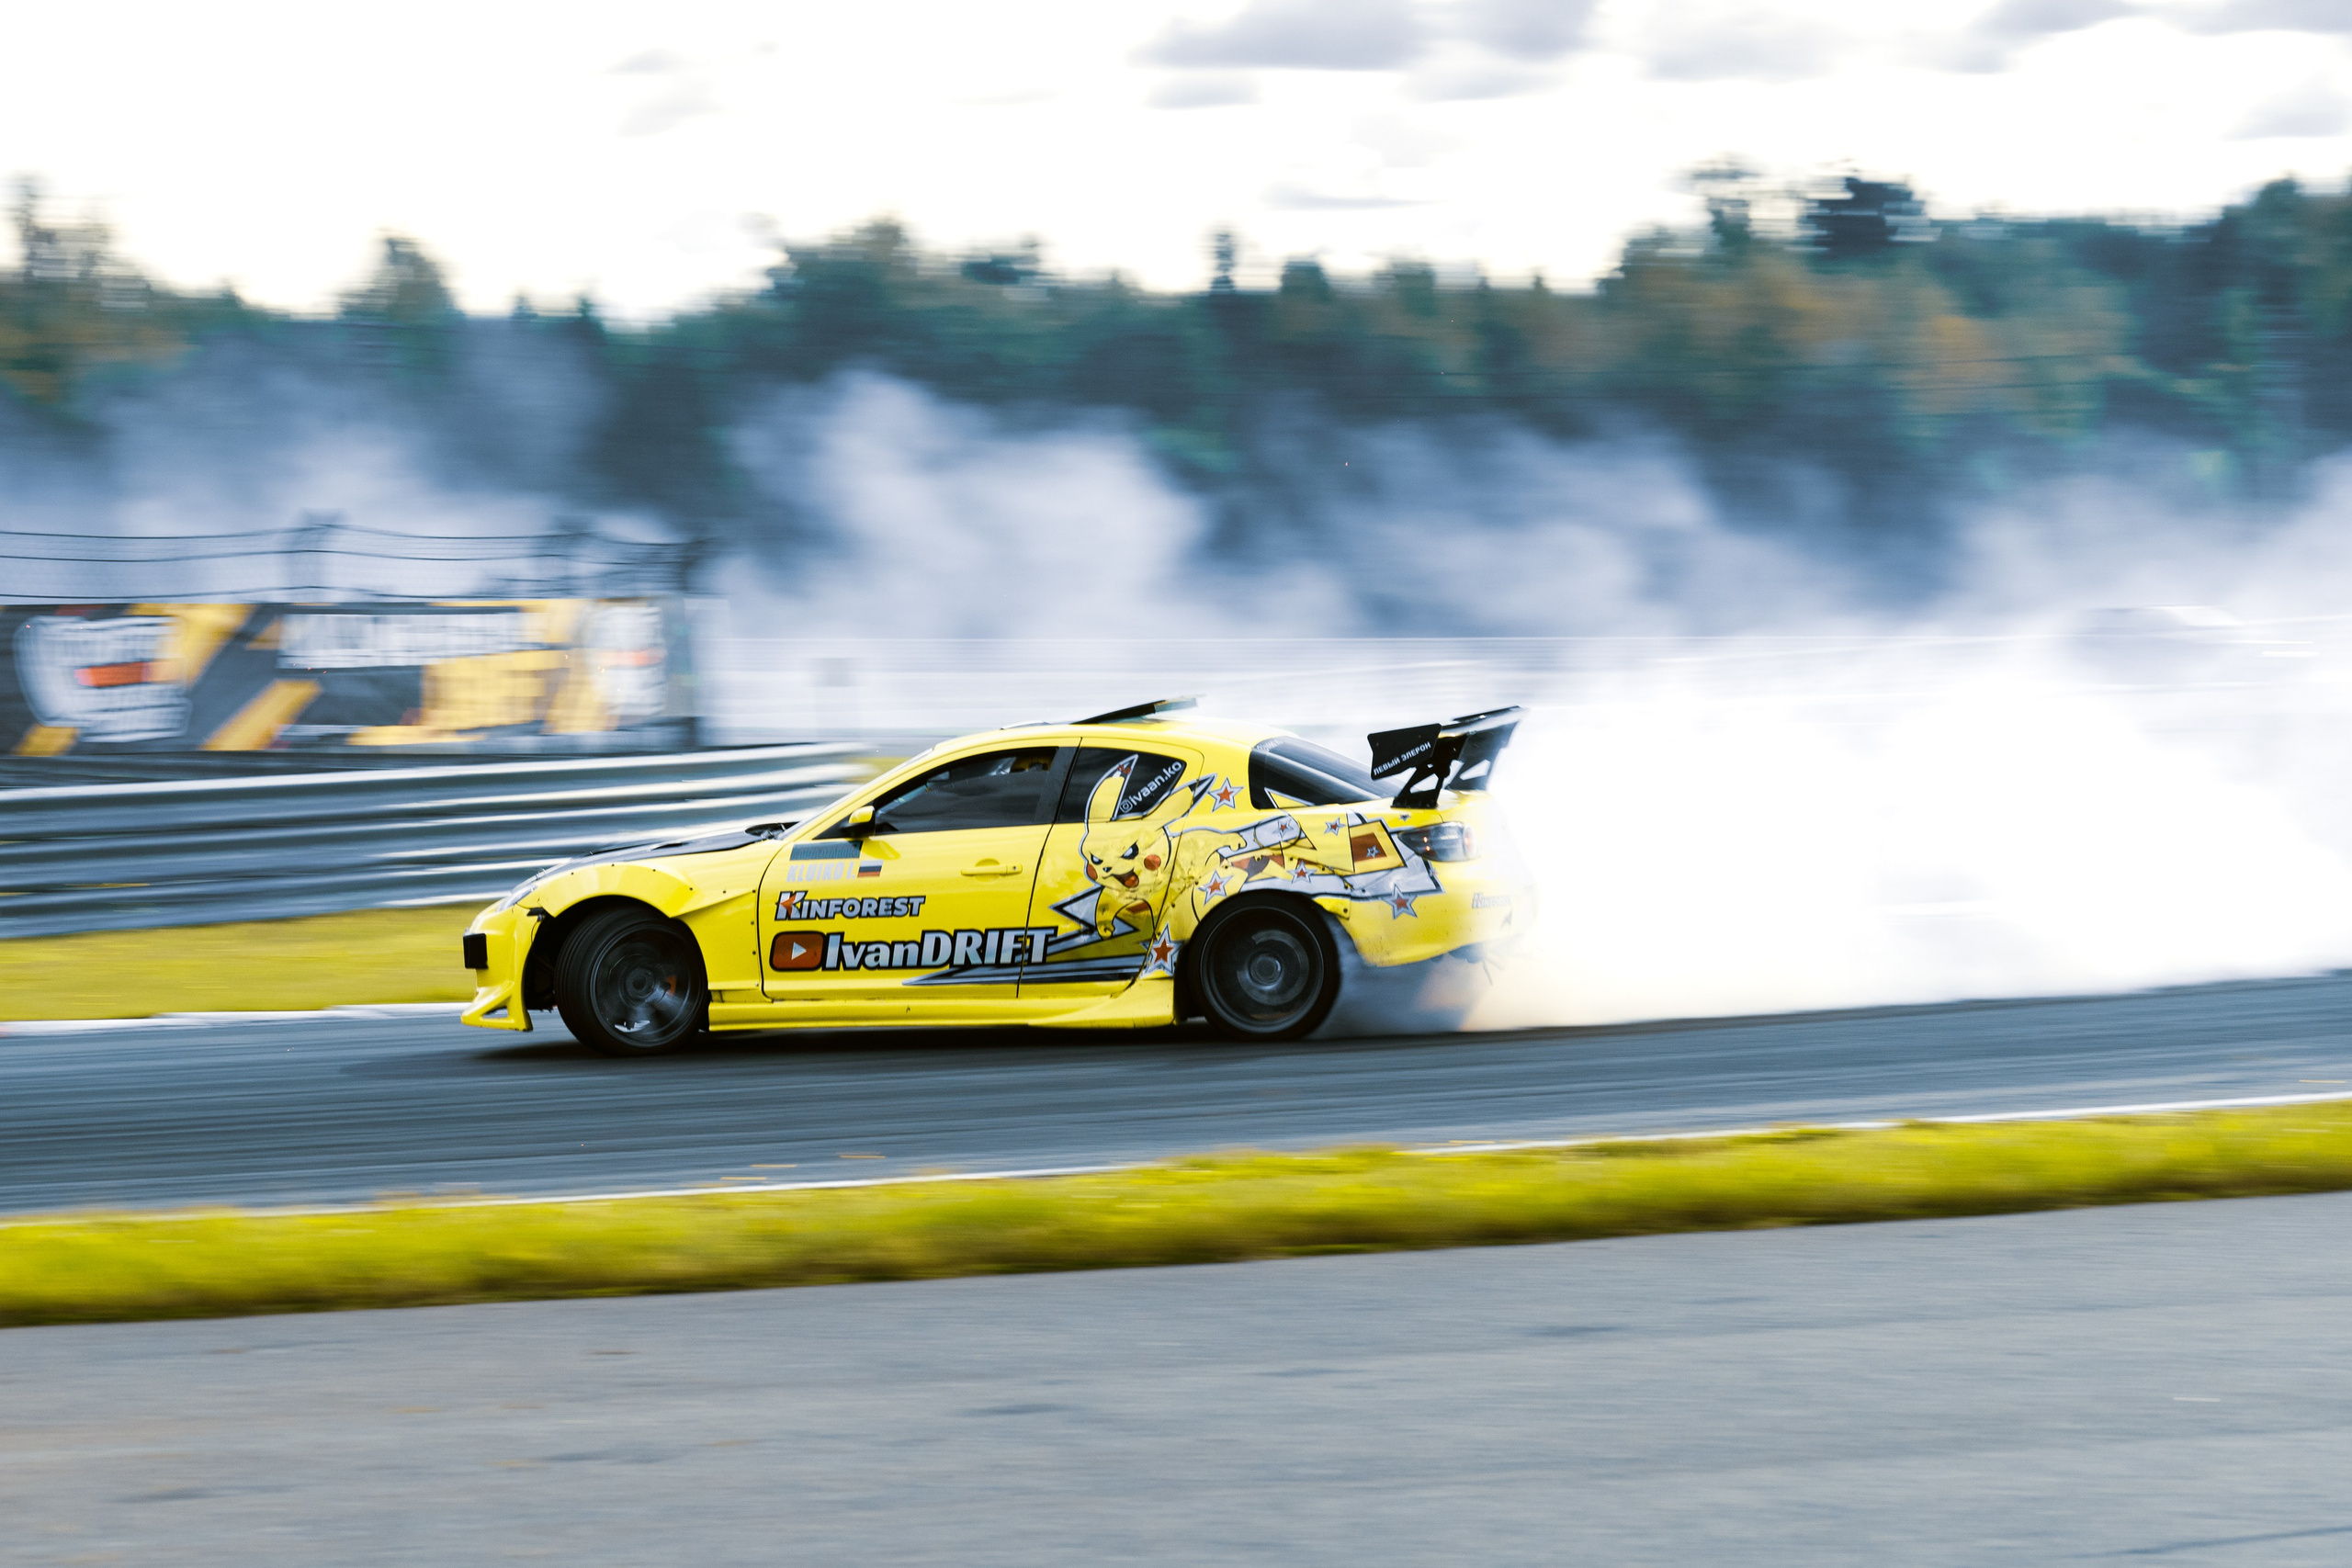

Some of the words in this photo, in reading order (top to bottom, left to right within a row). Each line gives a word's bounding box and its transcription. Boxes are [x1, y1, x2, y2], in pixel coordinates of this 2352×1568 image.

[1373, 755, 1401, 776] ЛЕВЫЙ
[1401, 741, 1431, 762] ЭЛЕРОН
[1129, 761, 1182, 806] ivaan.ko
[824, 927, 1057, 970] IvanDRIFT
